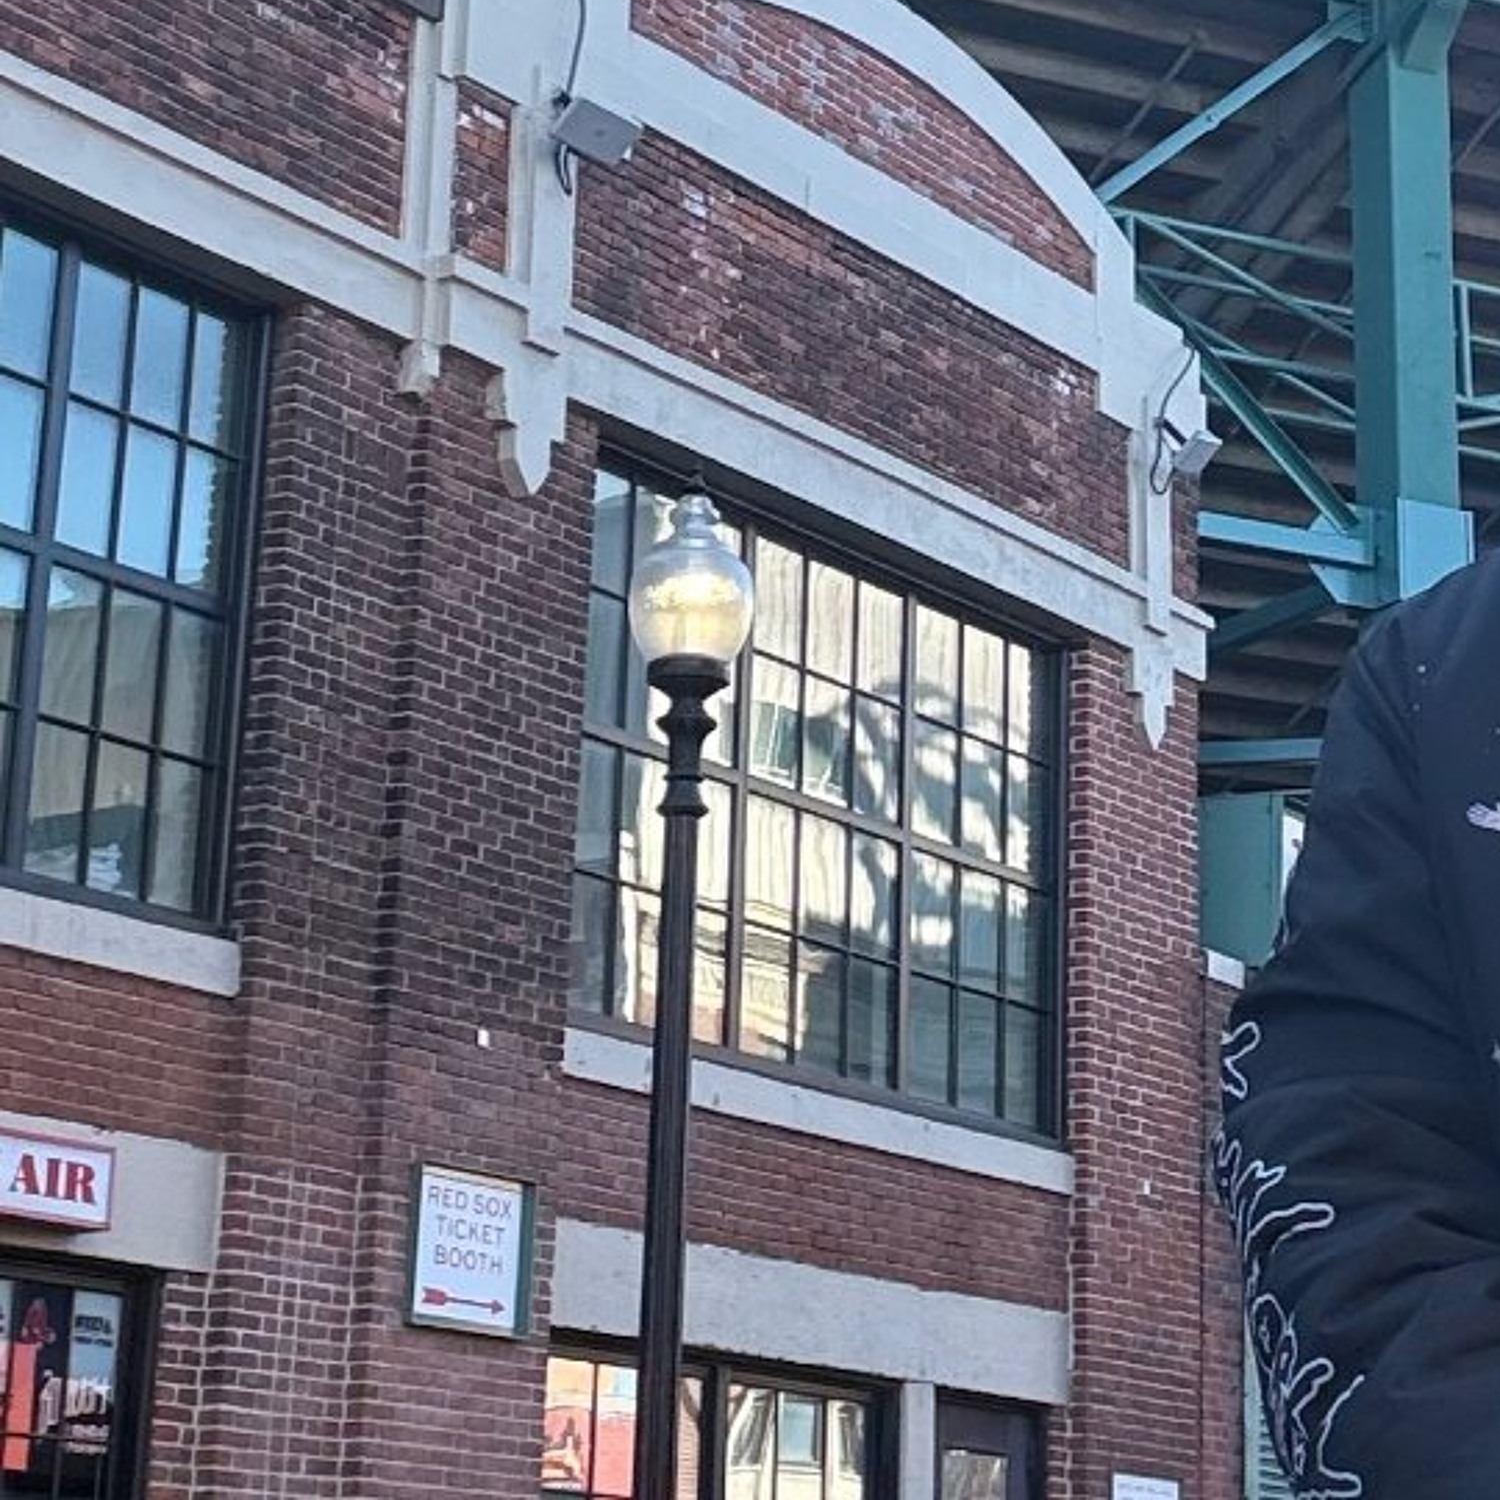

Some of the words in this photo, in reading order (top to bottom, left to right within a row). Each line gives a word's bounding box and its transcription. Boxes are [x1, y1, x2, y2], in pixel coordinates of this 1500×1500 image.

[7, 1153, 97, 1206] AIR
[427, 1184, 469, 1211] RED
[472, 1193, 513, 1221] SOX
[435, 1213, 507, 1248] TICKET
[433, 1244, 503, 1274] BOOTH
